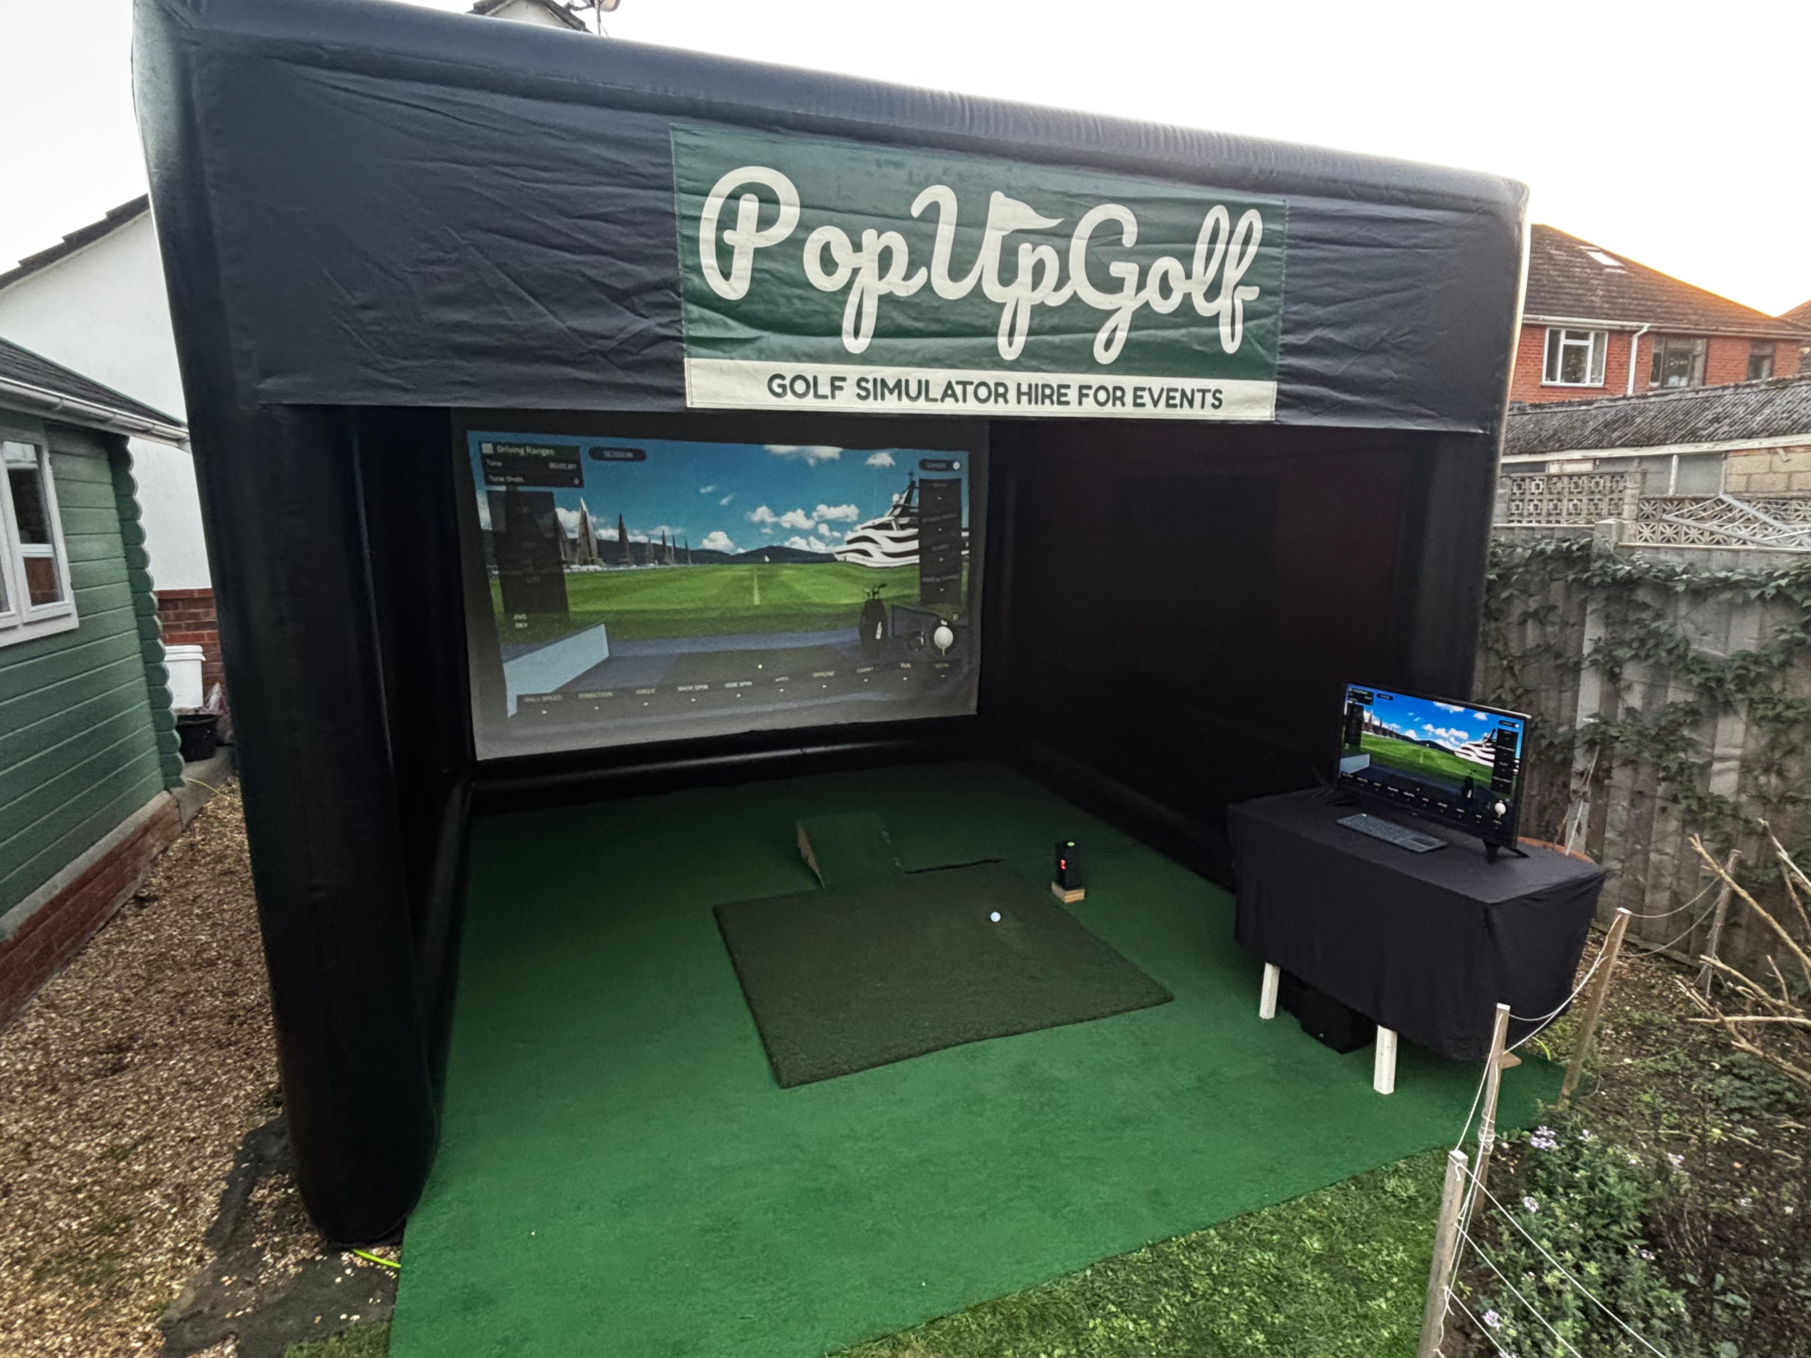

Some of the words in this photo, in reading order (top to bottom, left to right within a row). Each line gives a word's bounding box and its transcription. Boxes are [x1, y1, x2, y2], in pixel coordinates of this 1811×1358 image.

[699, 165, 1264, 364] PopUpGolf
[767, 373, 847, 400] GOLF
[855, 375, 1009, 405] SIMULATOR
[1016, 382, 1071, 406] HIRE
[1078, 384, 1126, 408] FOR
[1132, 386, 1223, 410] EVENTS
